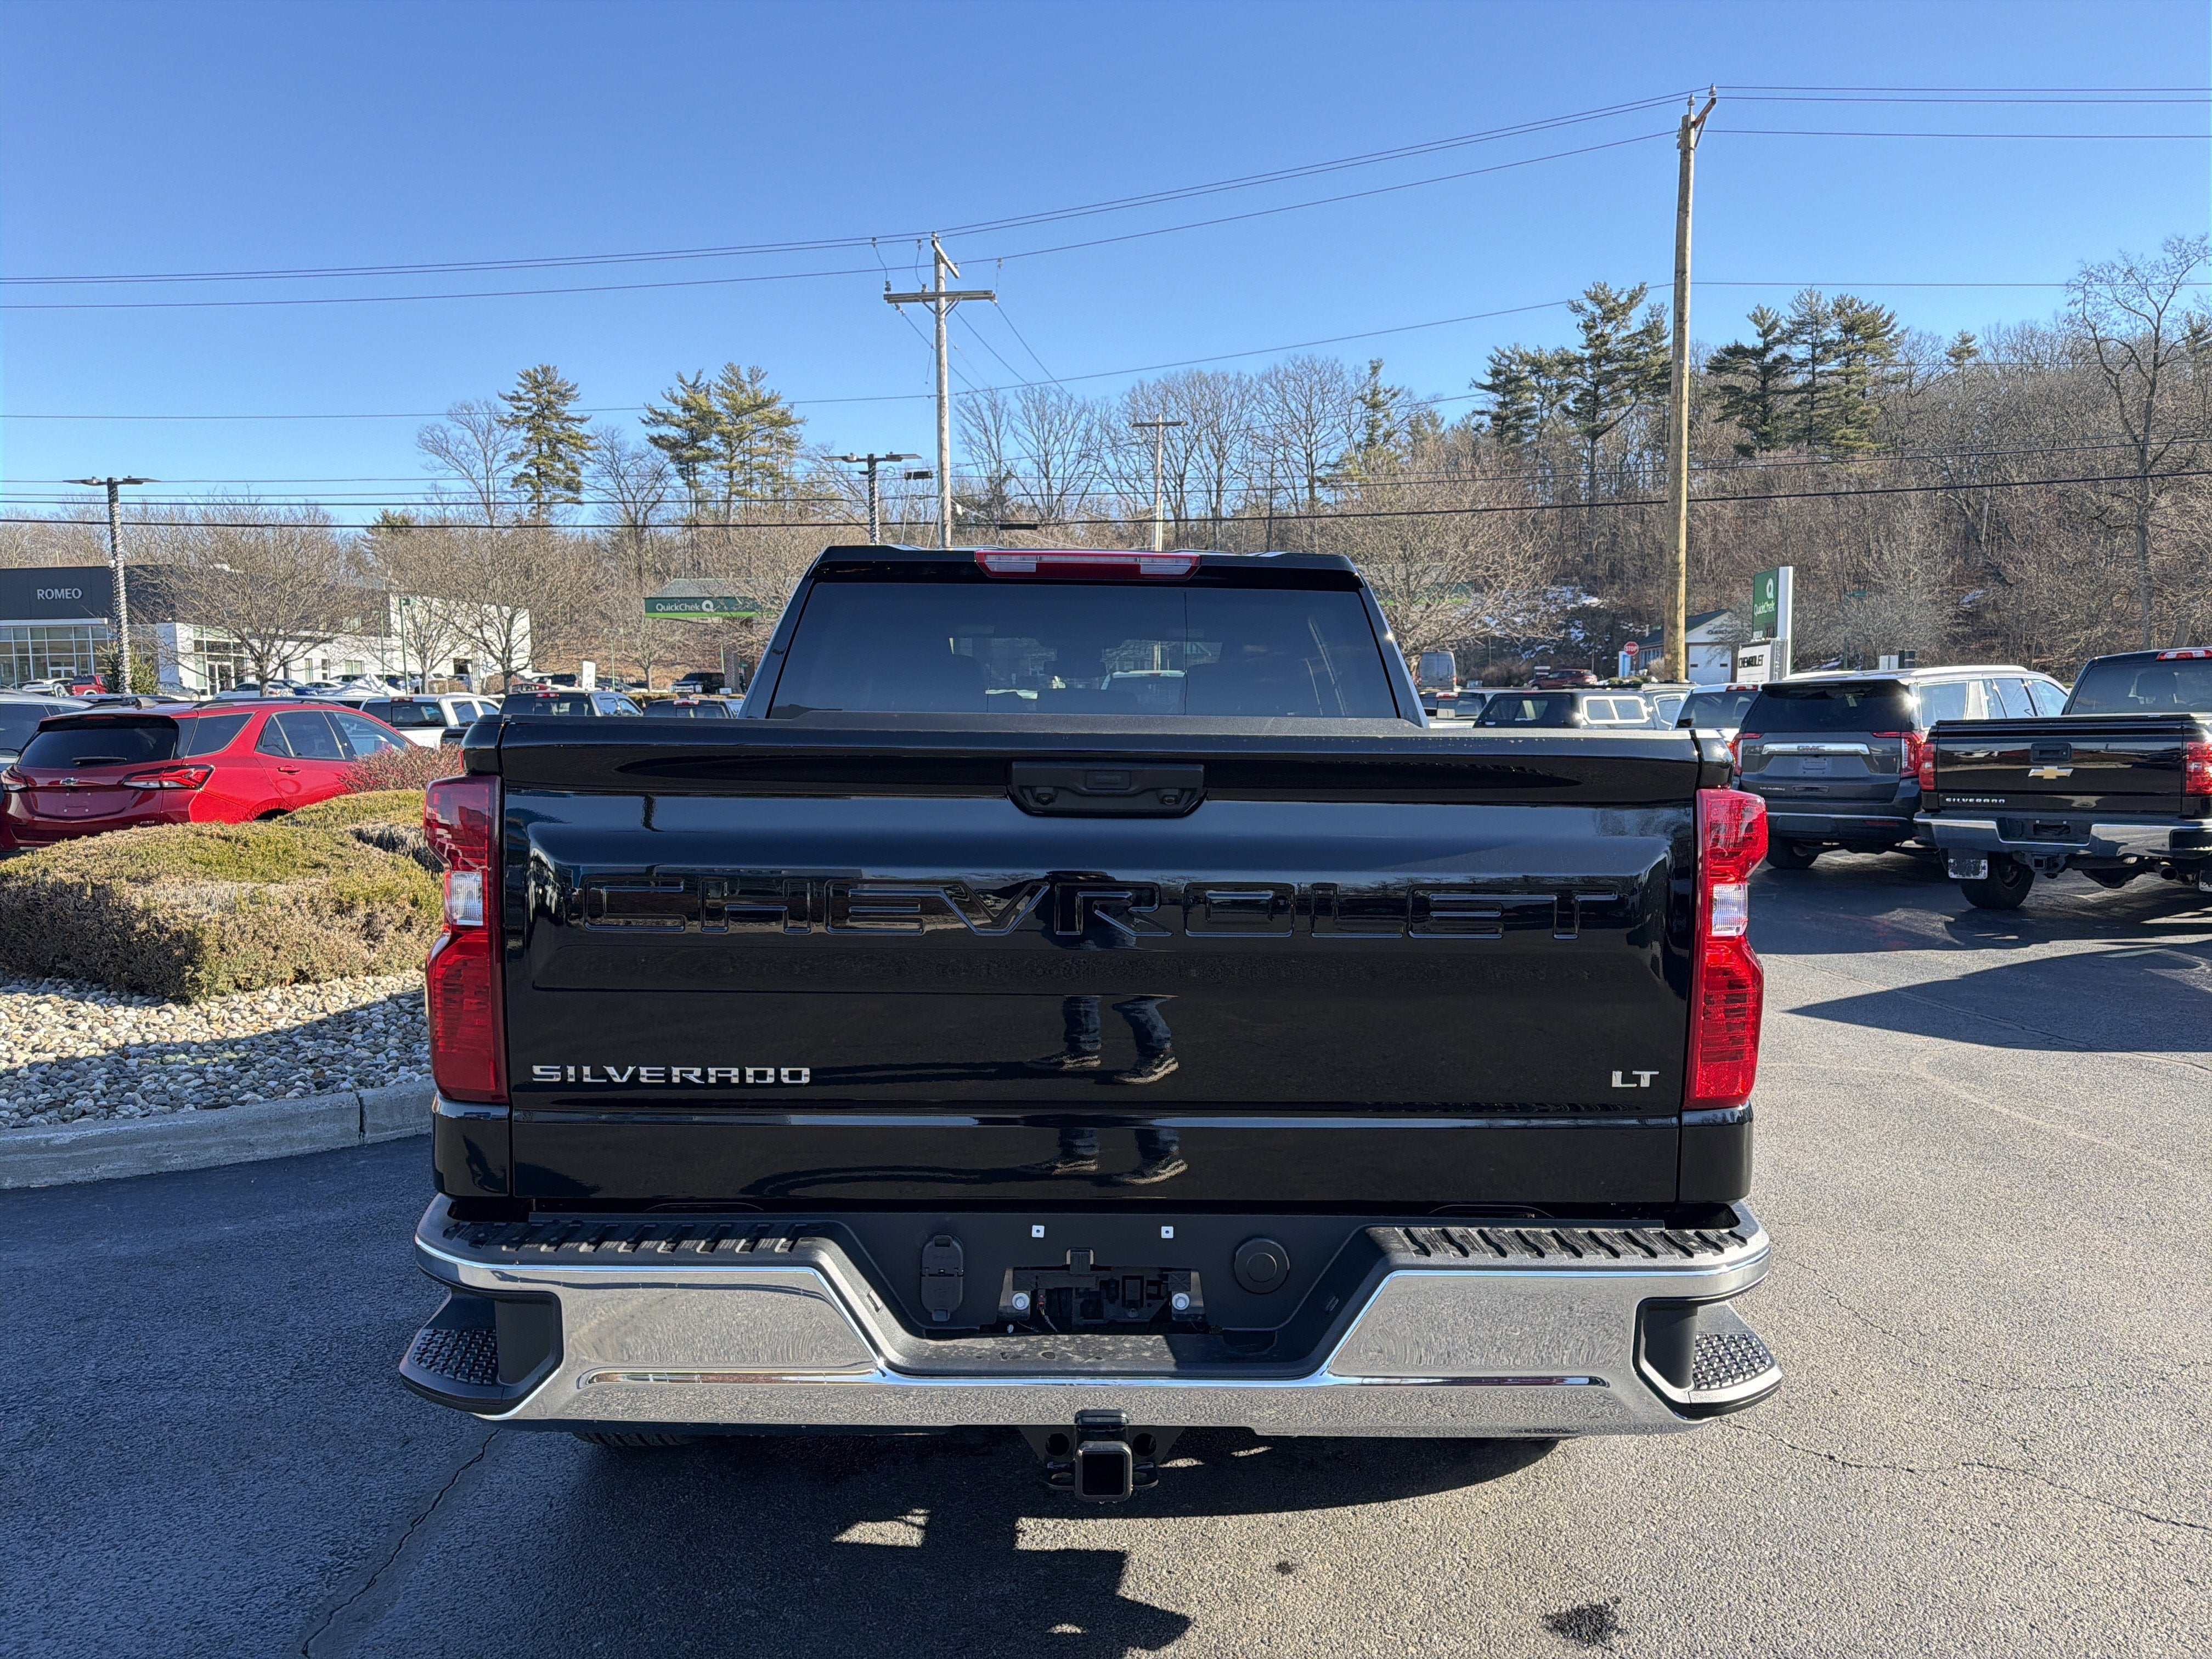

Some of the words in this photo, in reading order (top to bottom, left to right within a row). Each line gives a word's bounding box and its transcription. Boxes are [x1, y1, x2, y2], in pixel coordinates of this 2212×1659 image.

[37, 588, 82, 600] ROMEO
[656, 603, 701, 612] QuickChek
[1754, 600, 1775, 617] QuickChek
[583, 878, 1618, 940] CHEVROLET
[532, 1065, 810, 1084] SILVERADO
[1611, 1070, 1660, 1087] LT
